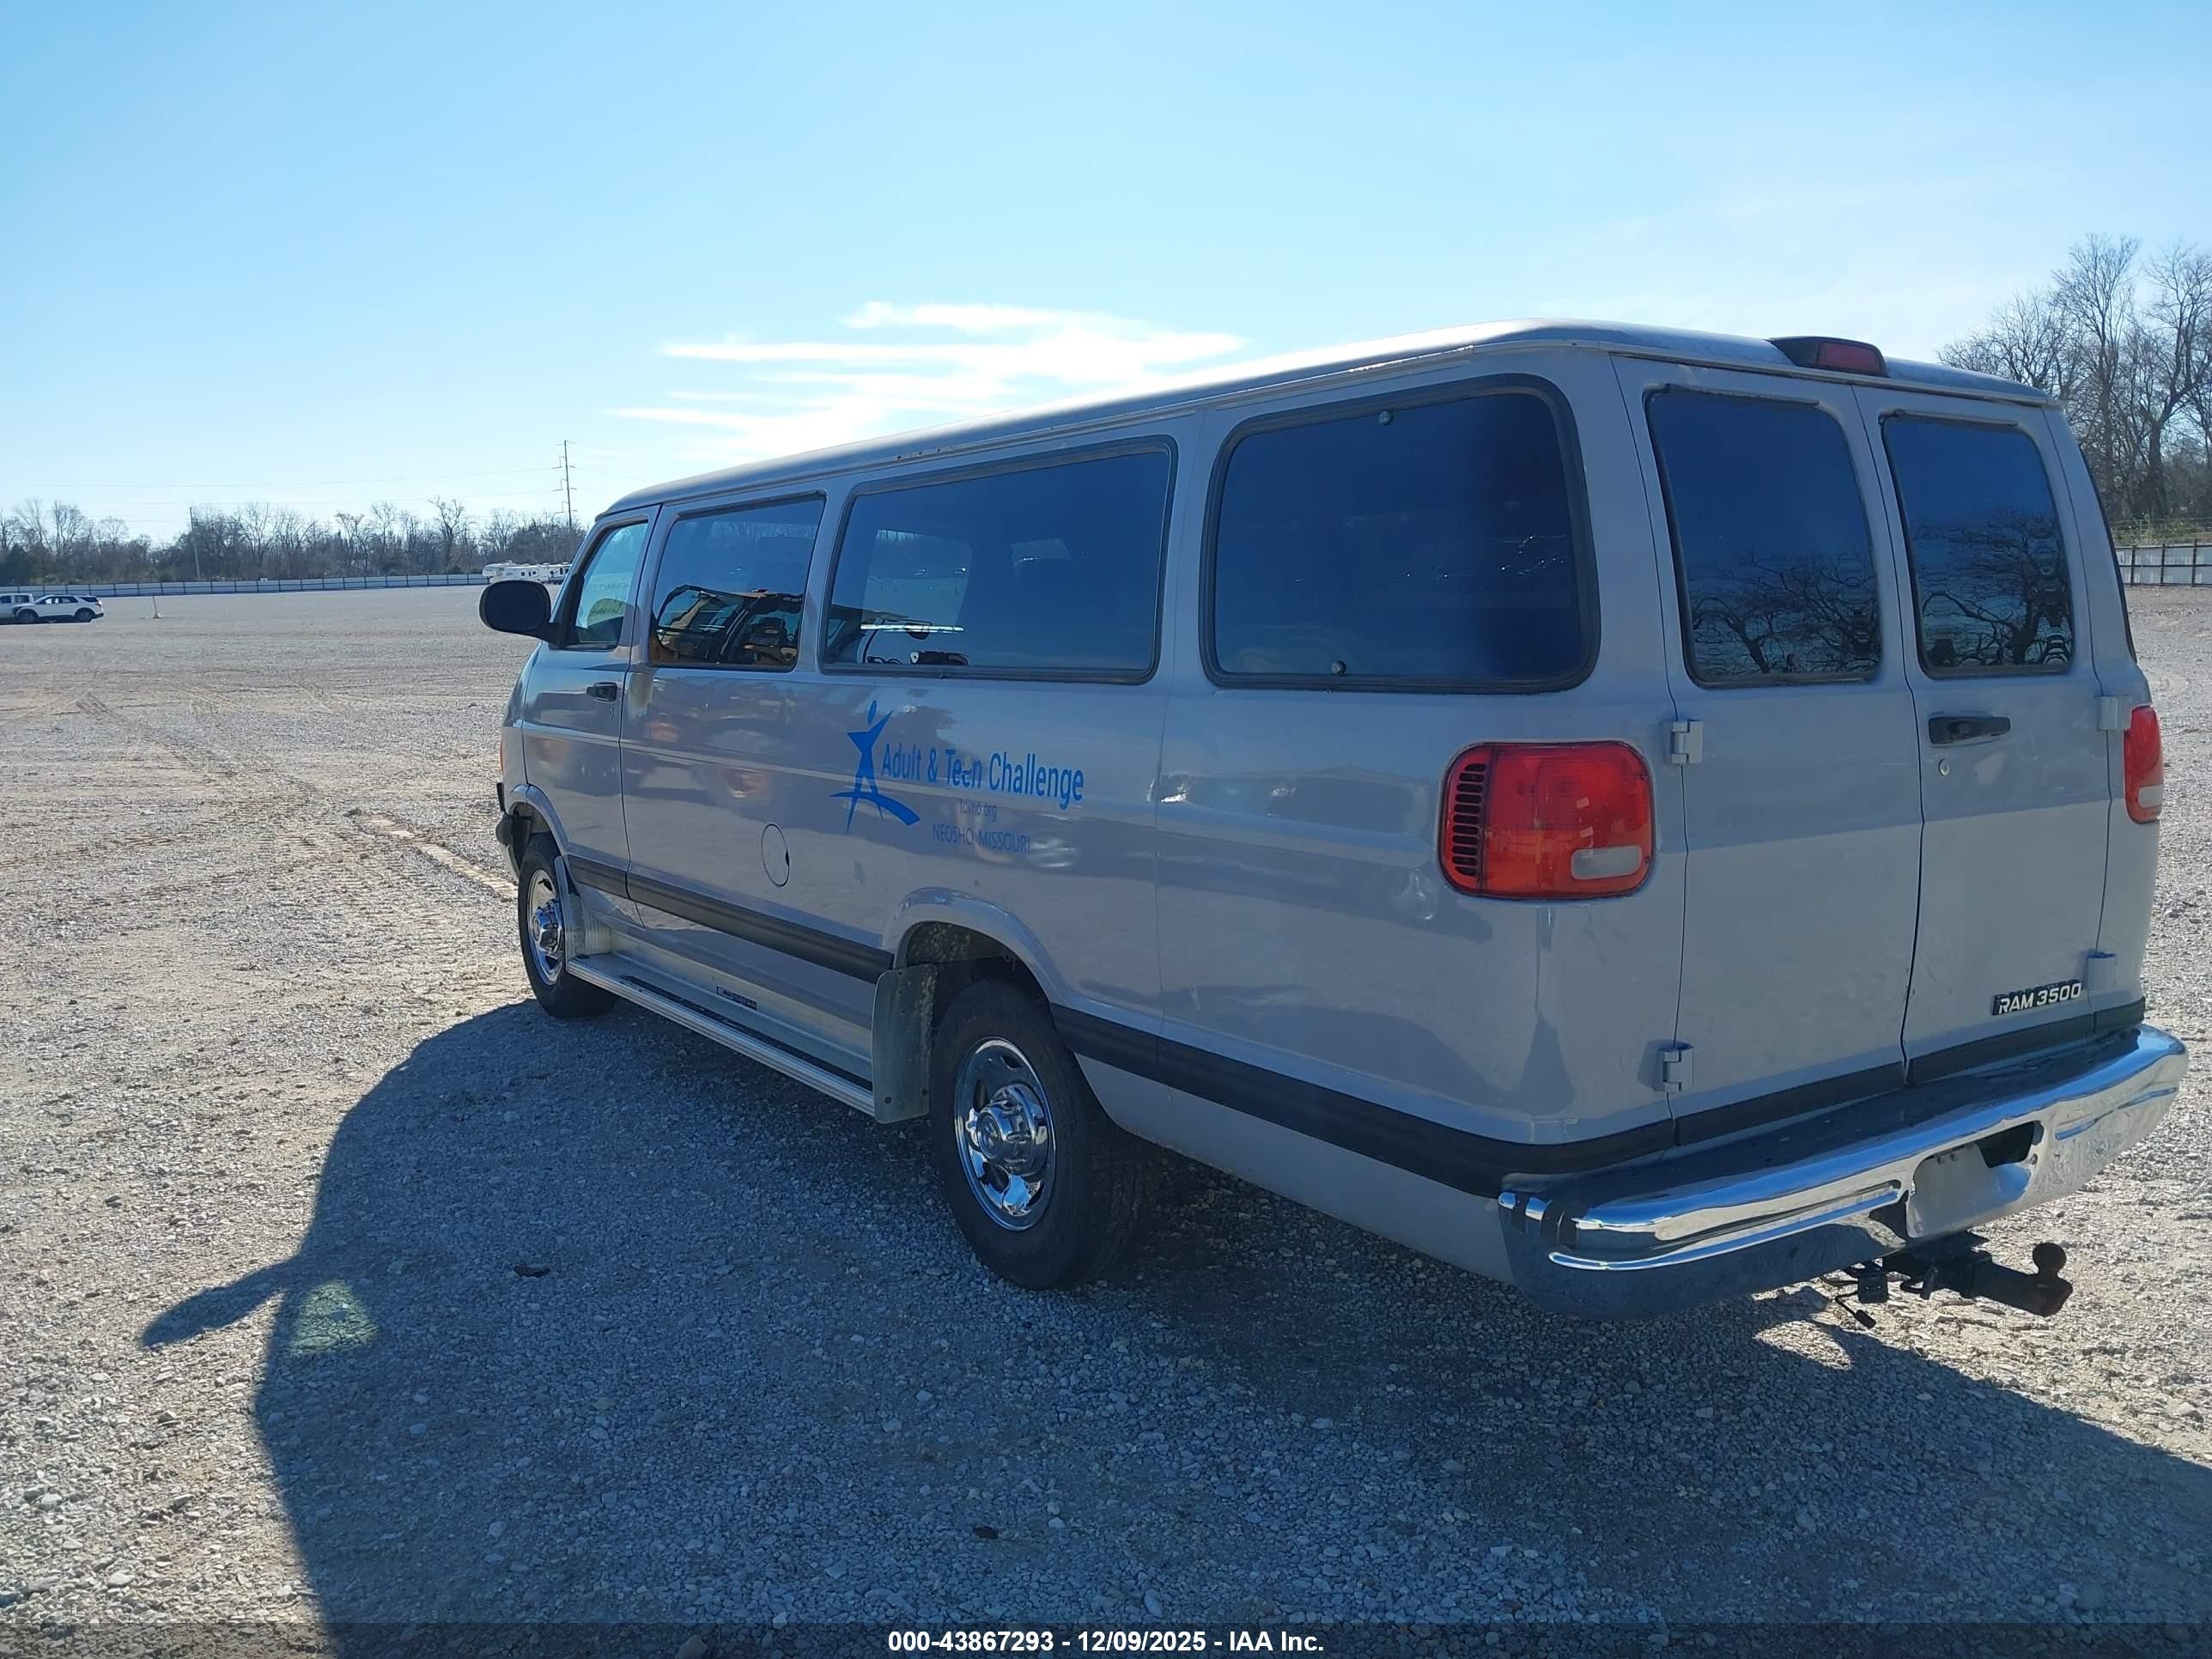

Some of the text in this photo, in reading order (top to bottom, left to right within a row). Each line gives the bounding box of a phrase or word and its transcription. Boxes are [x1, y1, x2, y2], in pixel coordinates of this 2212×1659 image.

[880, 742, 922, 781] Adult
[927, 748, 939, 783] &
[988, 752, 1085, 810] Challenge
[979, 830, 1030, 853] MISSOURI
[1998, 982, 2081, 1015] RAM 3500
